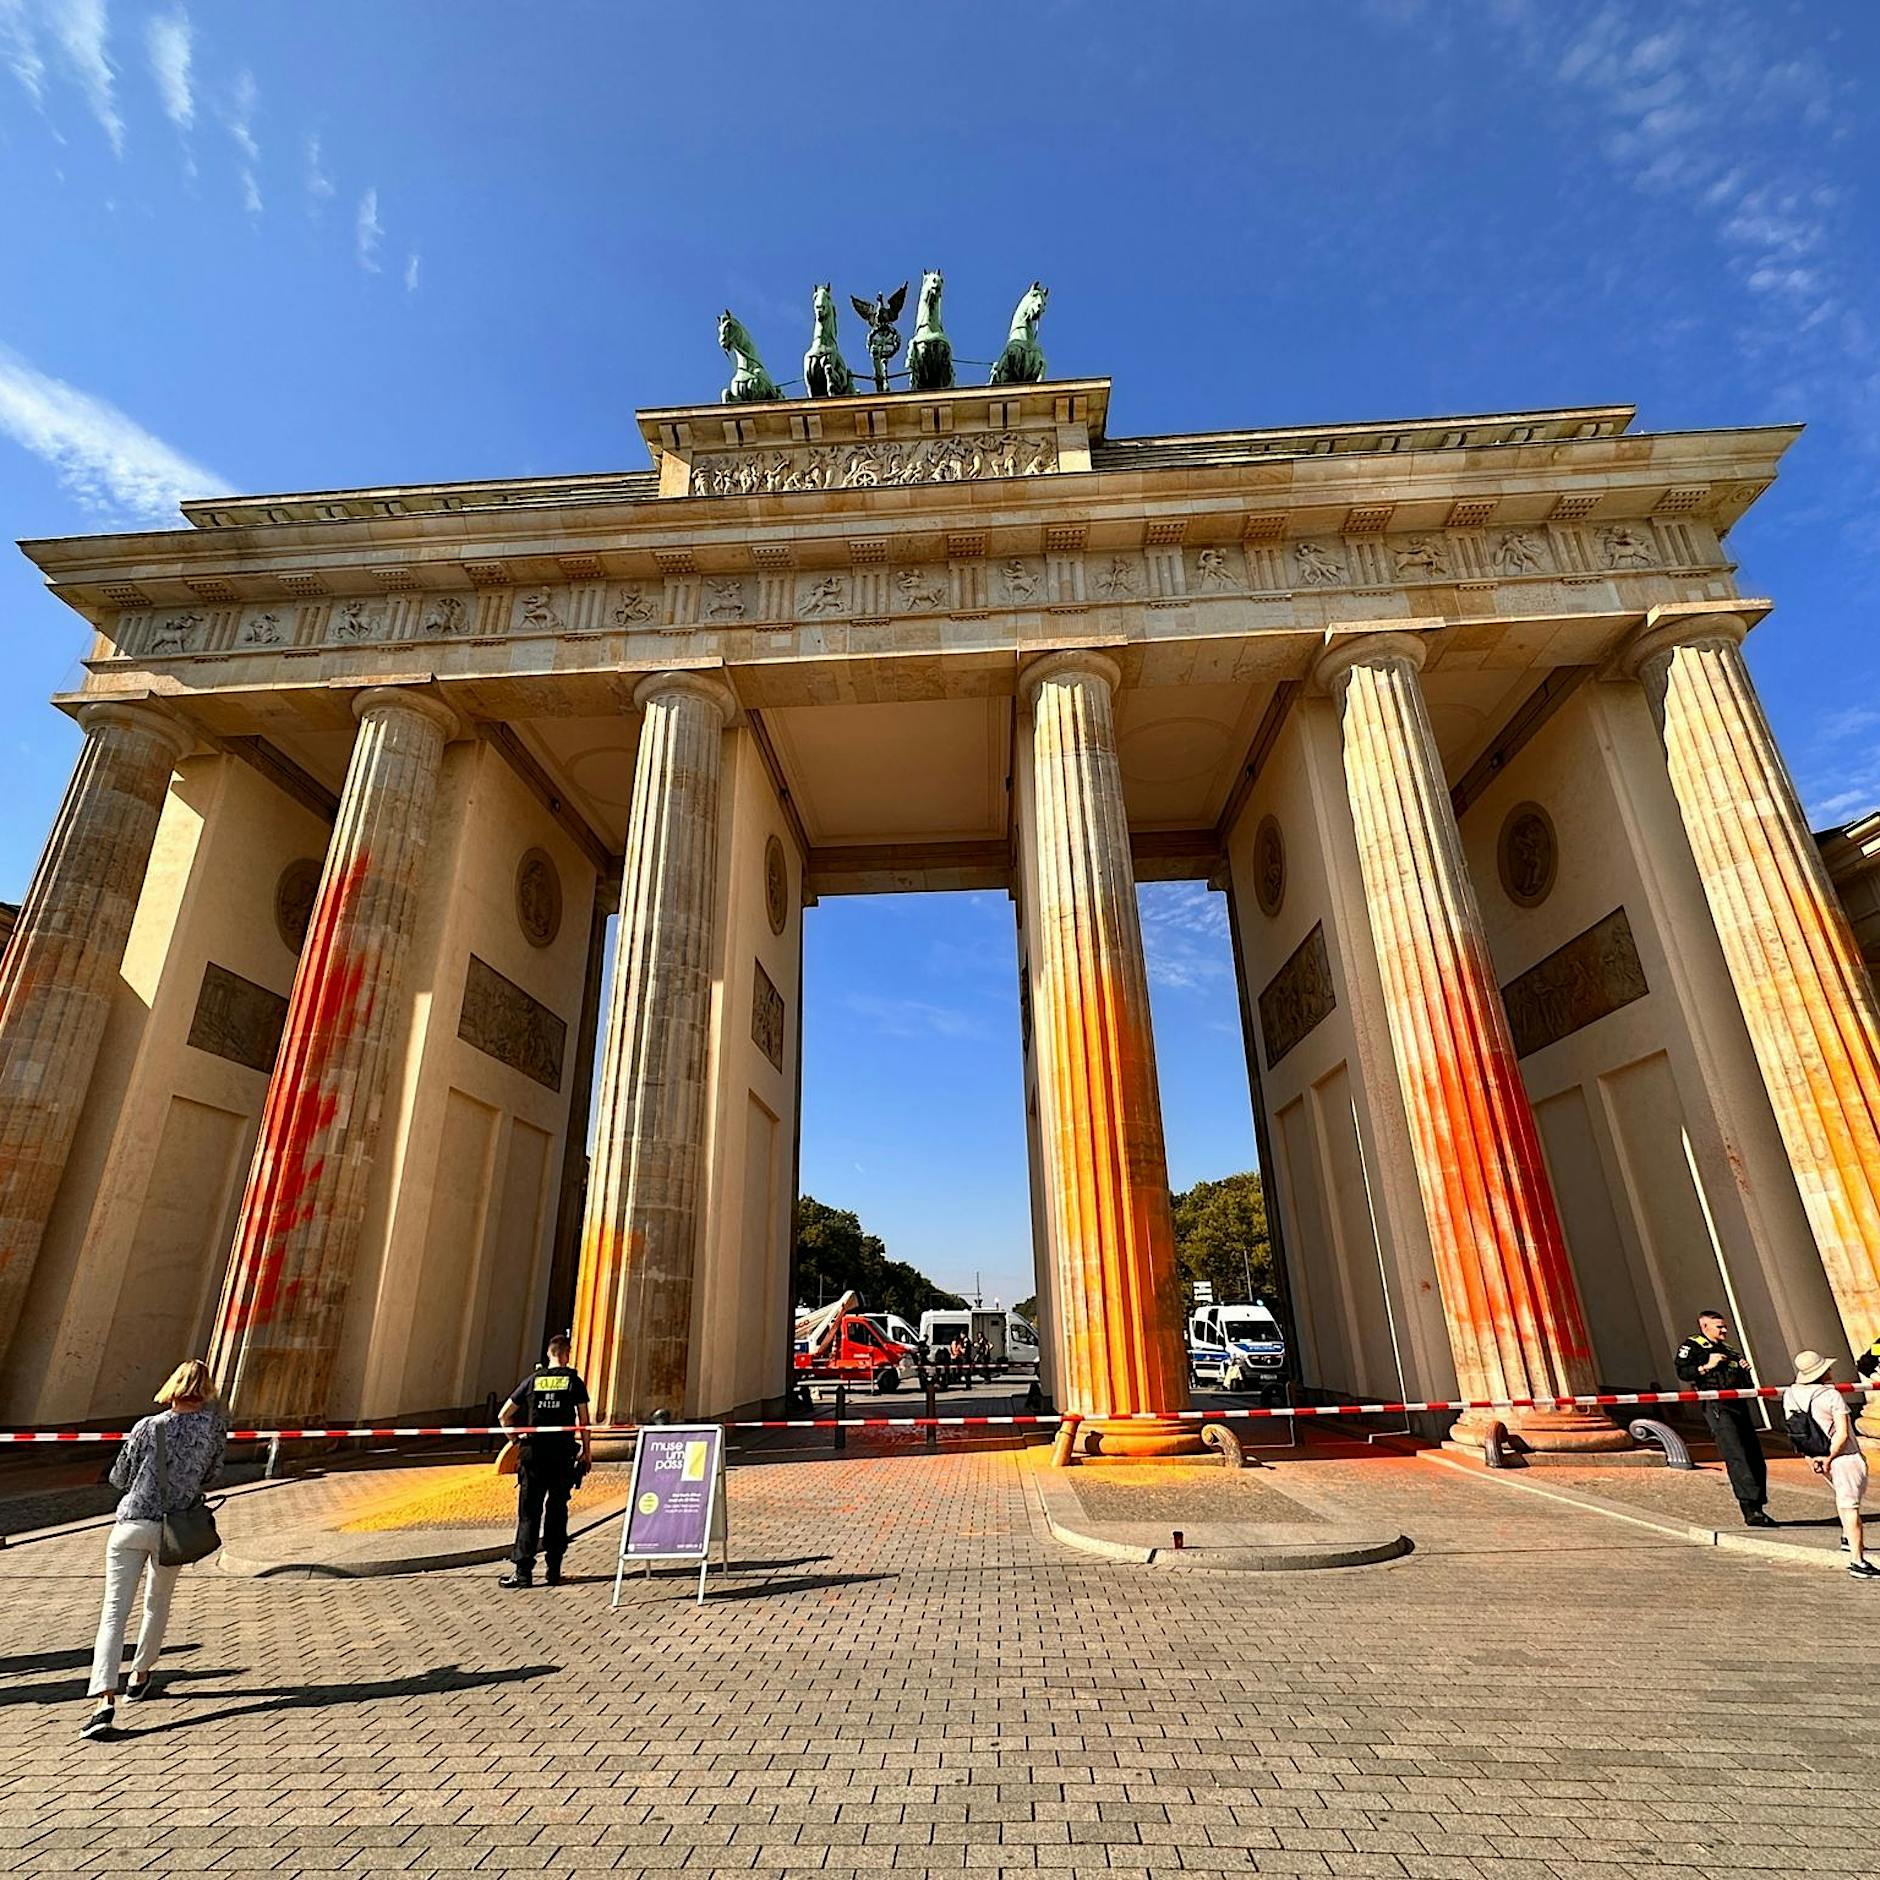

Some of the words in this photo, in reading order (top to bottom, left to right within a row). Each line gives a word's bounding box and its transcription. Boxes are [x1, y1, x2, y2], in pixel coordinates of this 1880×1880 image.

[650, 1441, 684, 1452] muse
[666, 1450, 685, 1460] um
[654, 1459, 683, 1472] pass
